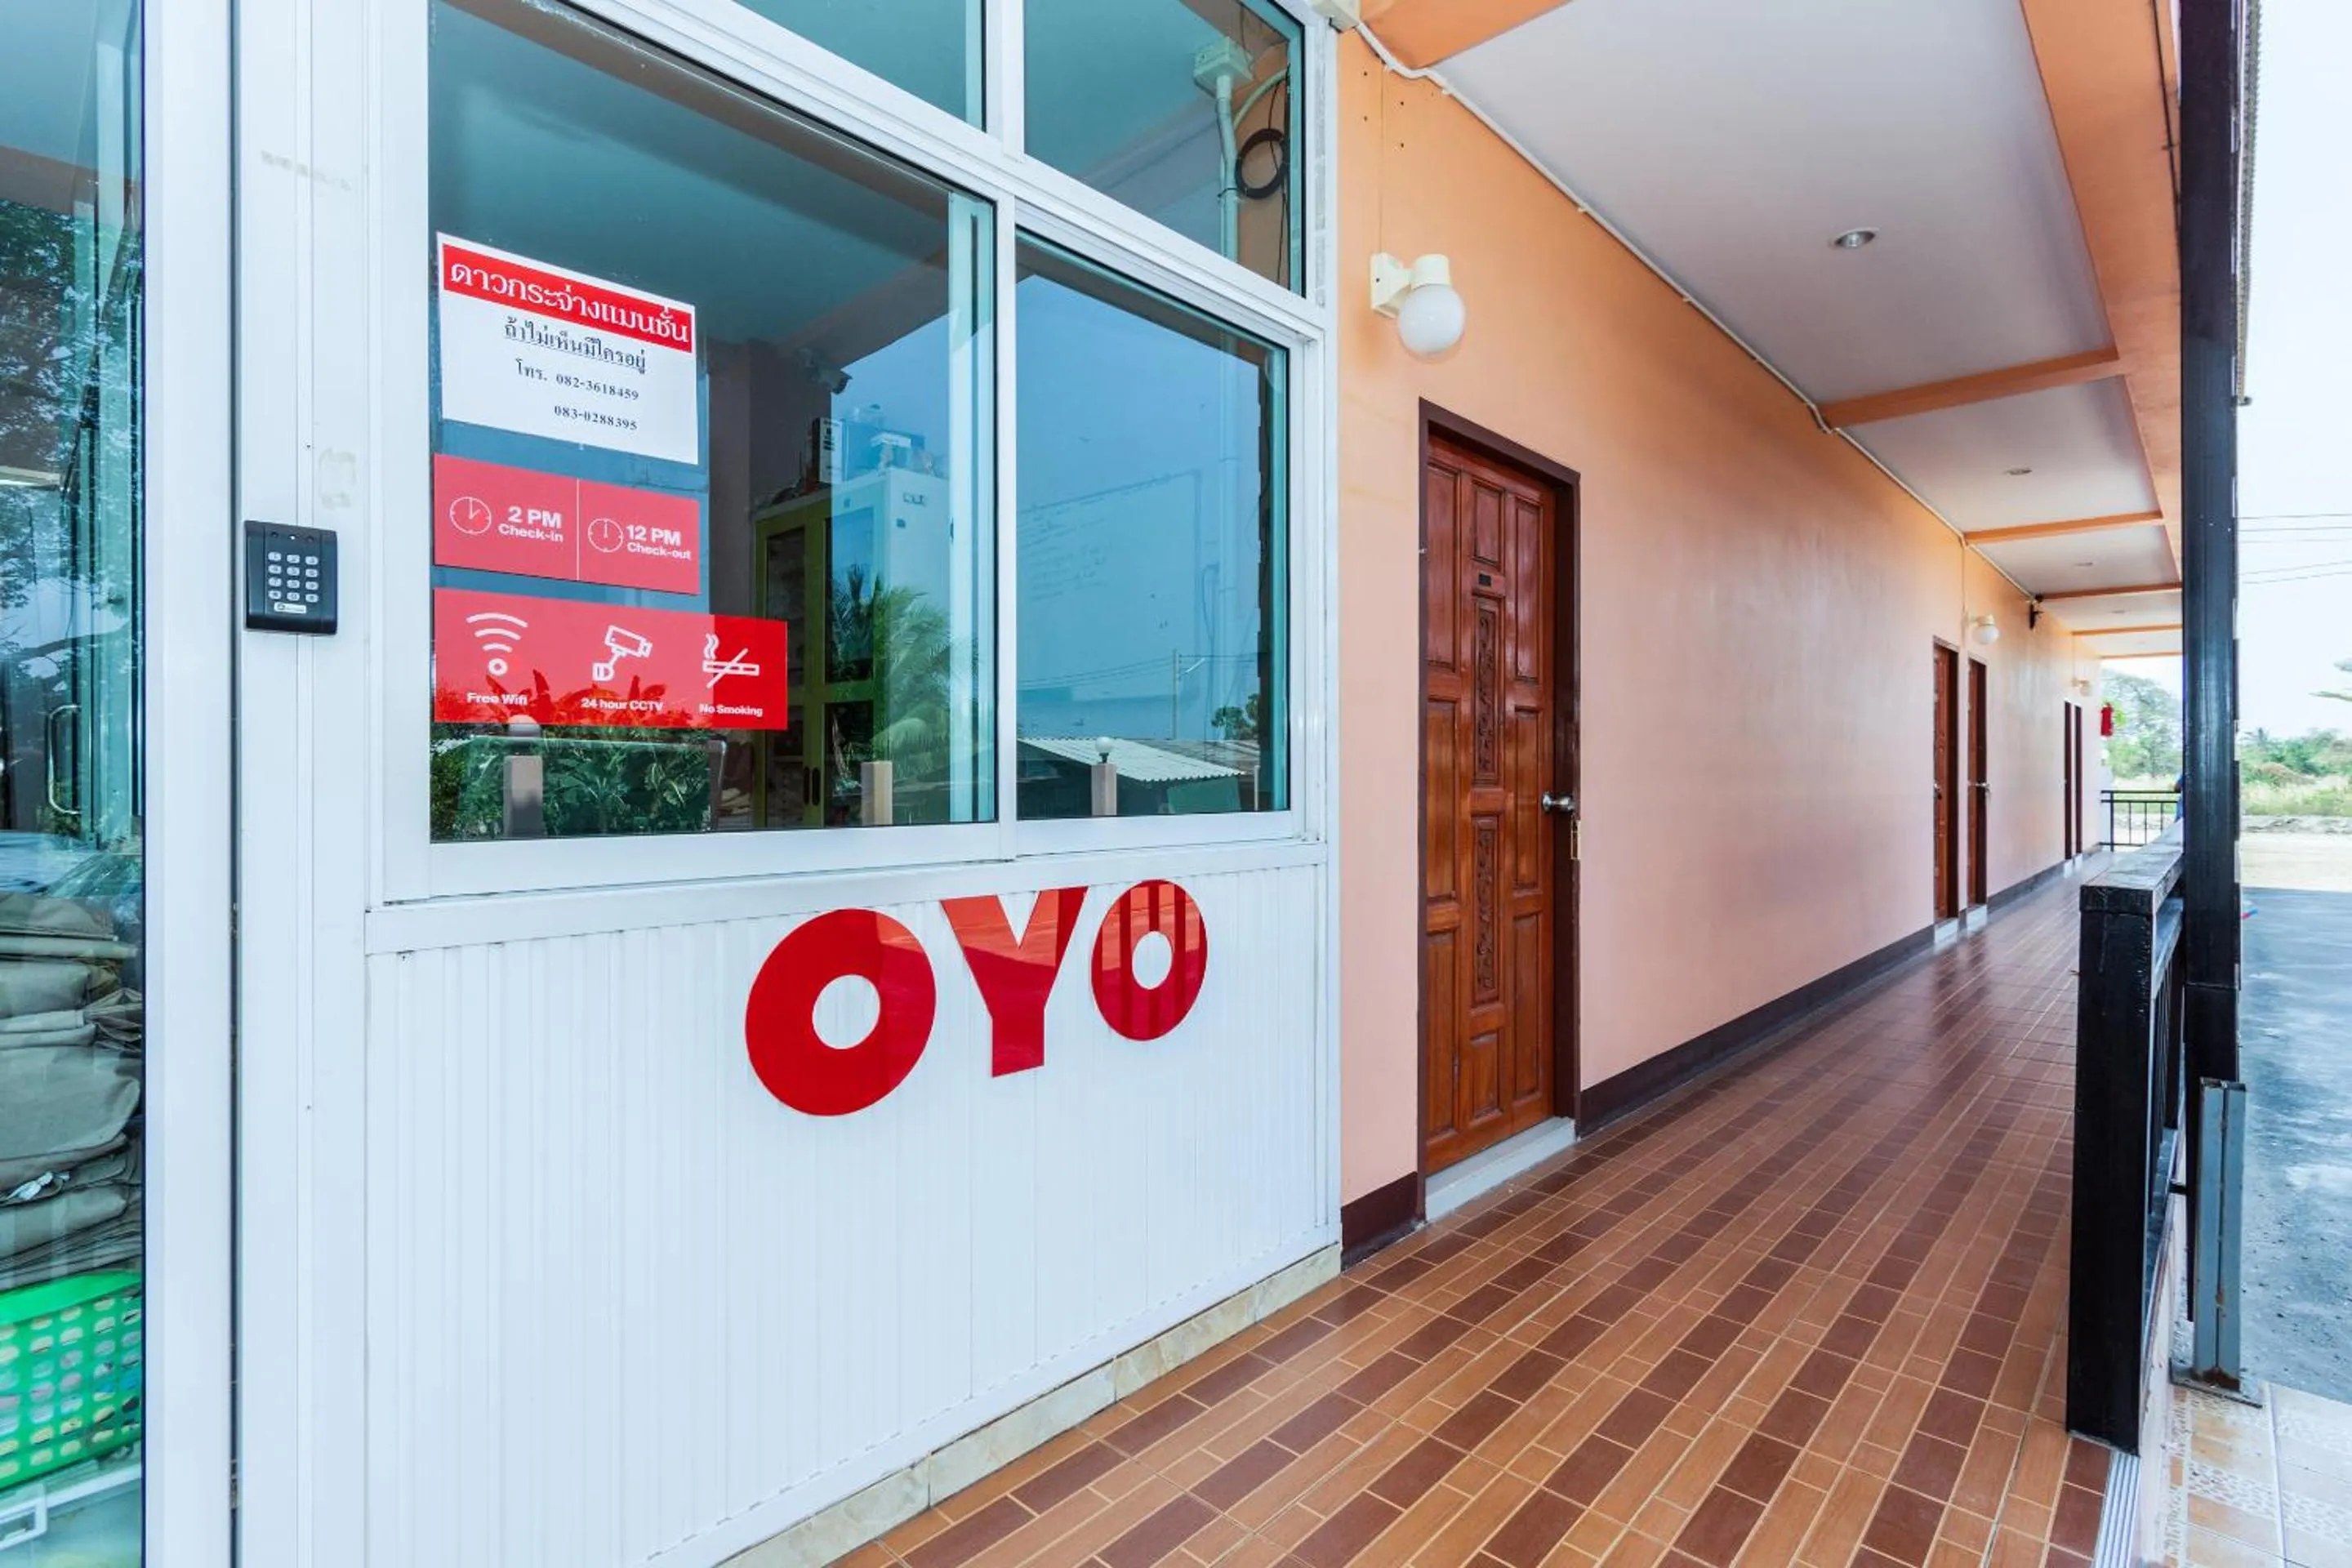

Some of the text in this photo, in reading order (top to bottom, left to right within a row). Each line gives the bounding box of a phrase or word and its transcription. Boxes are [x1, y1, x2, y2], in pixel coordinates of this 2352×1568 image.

[450, 262, 689, 343] ดาวกระจ่างแมนชั่น
[514, 358, 639, 401] โทร. 082-3618459
[554, 404, 639, 431] 083-0288395
[507, 506, 562, 529] 2 PM
[497, 523, 564, 543] Check-in
[626, 524, 682, 546] 12 PM
[626, 541, 692, 561] Check-out
[466, 692, 528, 706] Free Wifi
[581, 697, 664, 712] 24 hour CCTV
[698, 703, 764, 718] No Smoking
[745, 878, 1208, 1117] OYO
